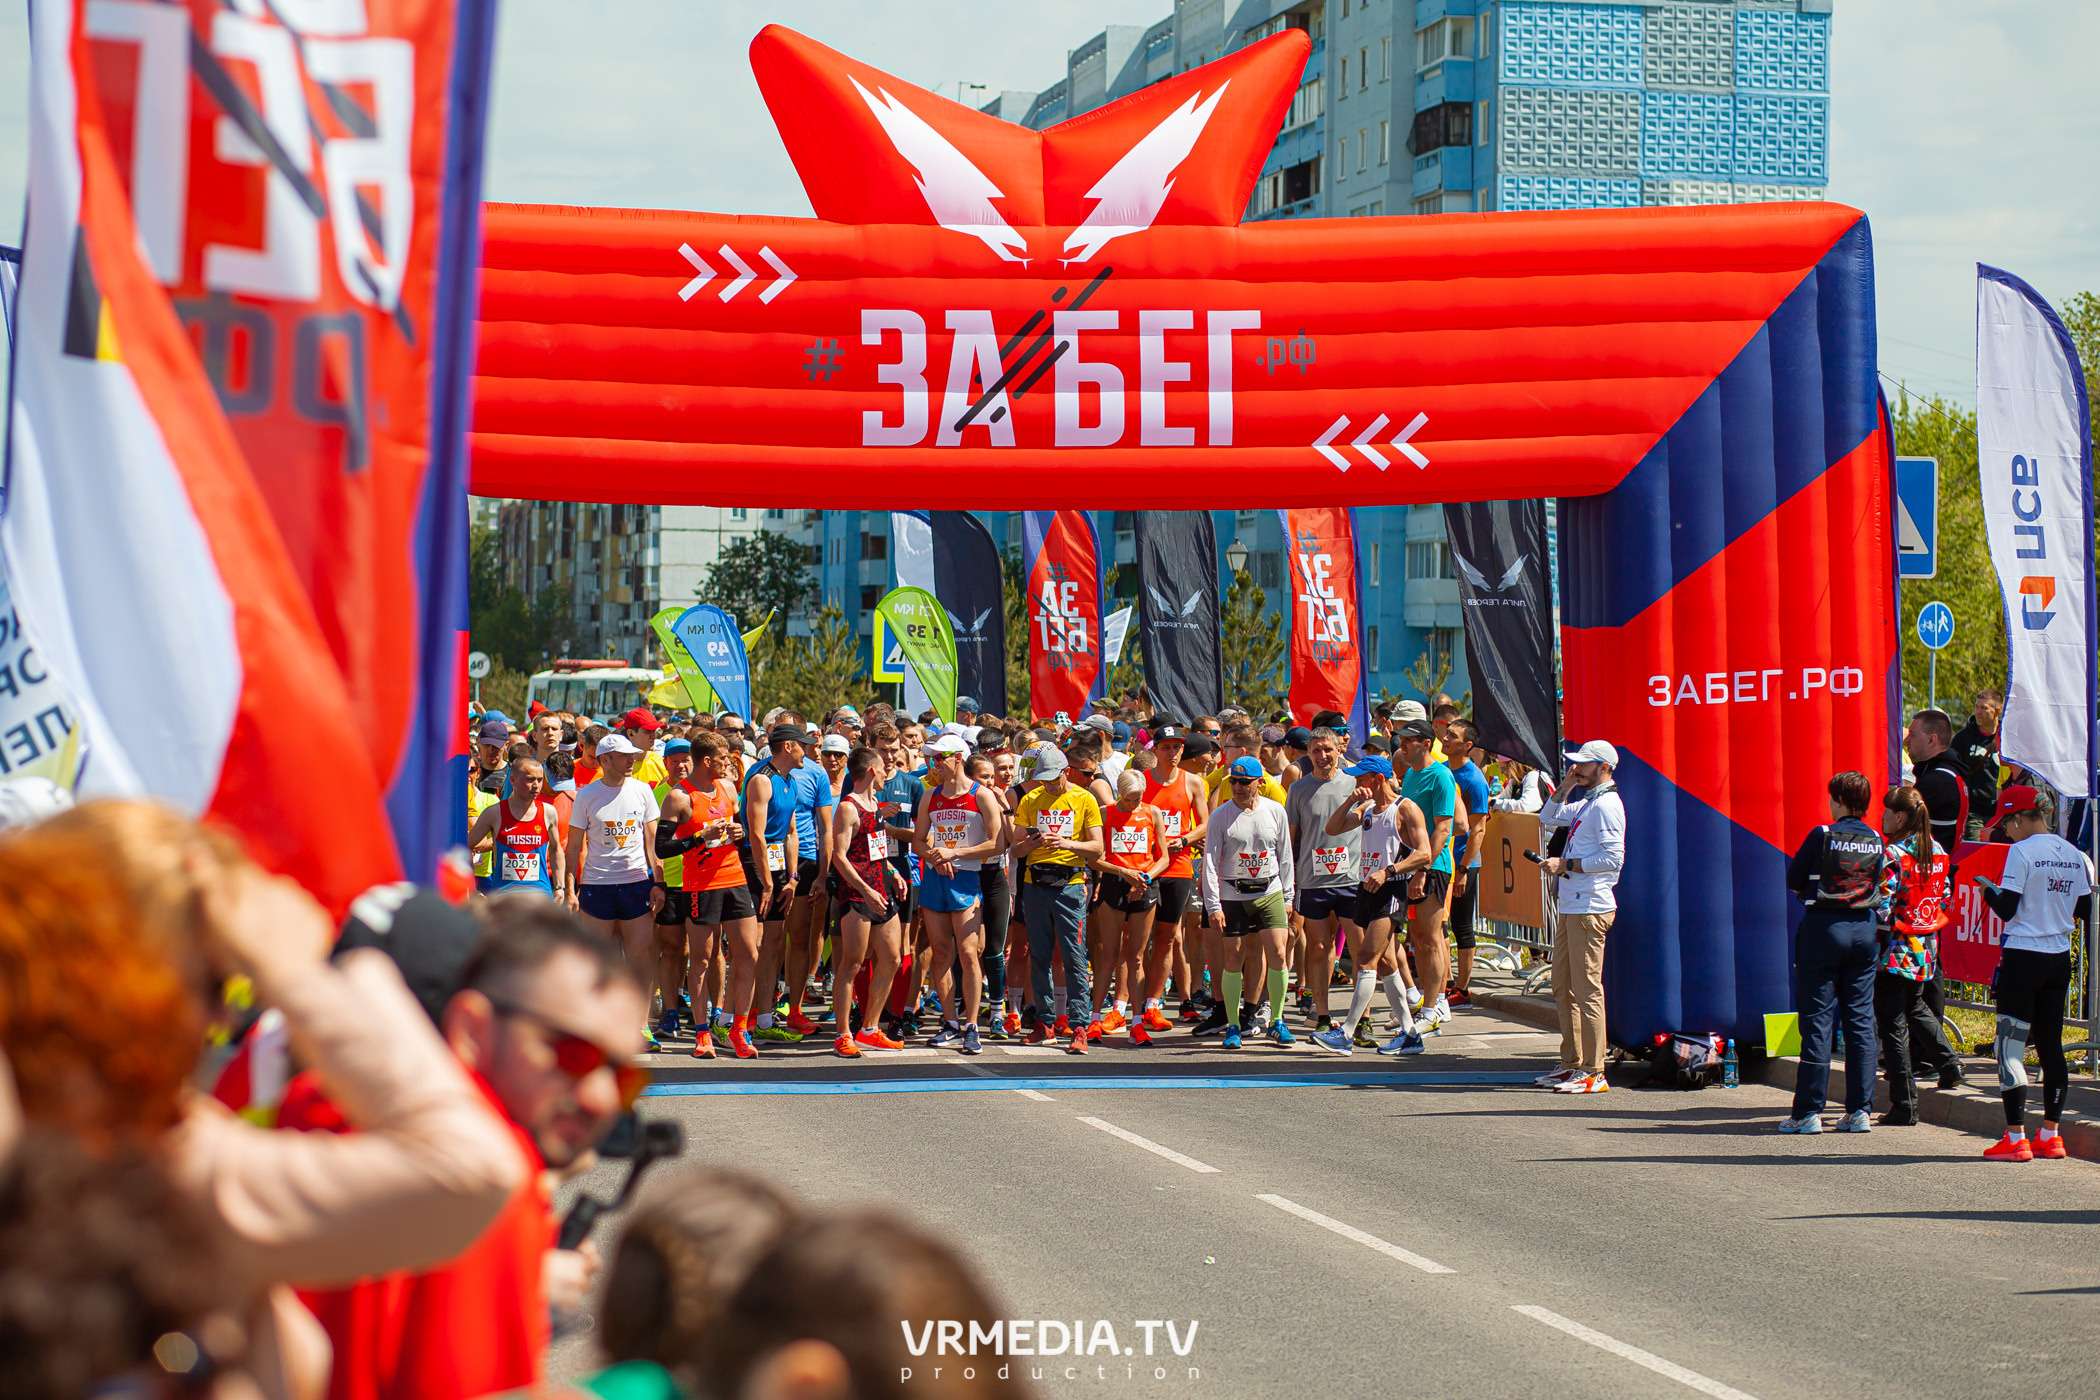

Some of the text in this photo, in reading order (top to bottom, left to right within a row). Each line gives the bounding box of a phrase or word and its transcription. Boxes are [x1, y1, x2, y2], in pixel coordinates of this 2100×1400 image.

[1648, 666, 1863, 707] ЗАБЕГ.РФ
[936, 810, 967, 822] RUSSIA
[1039, 816, 1072, 825] 20192
[604, 826, 636, 837] 30209
[936, 832, 966, 842] 30049
[506, 834, 542, 845] RUSSIA
[1113, 833, 1146, 842] 20206
[1830, 840, 1883, 854] МАРШАЛ
[505, 859, 538, 868] 20219
[1238, 857, 1269, 867] 20082
[1315, 853, 1347, 864] 20069
